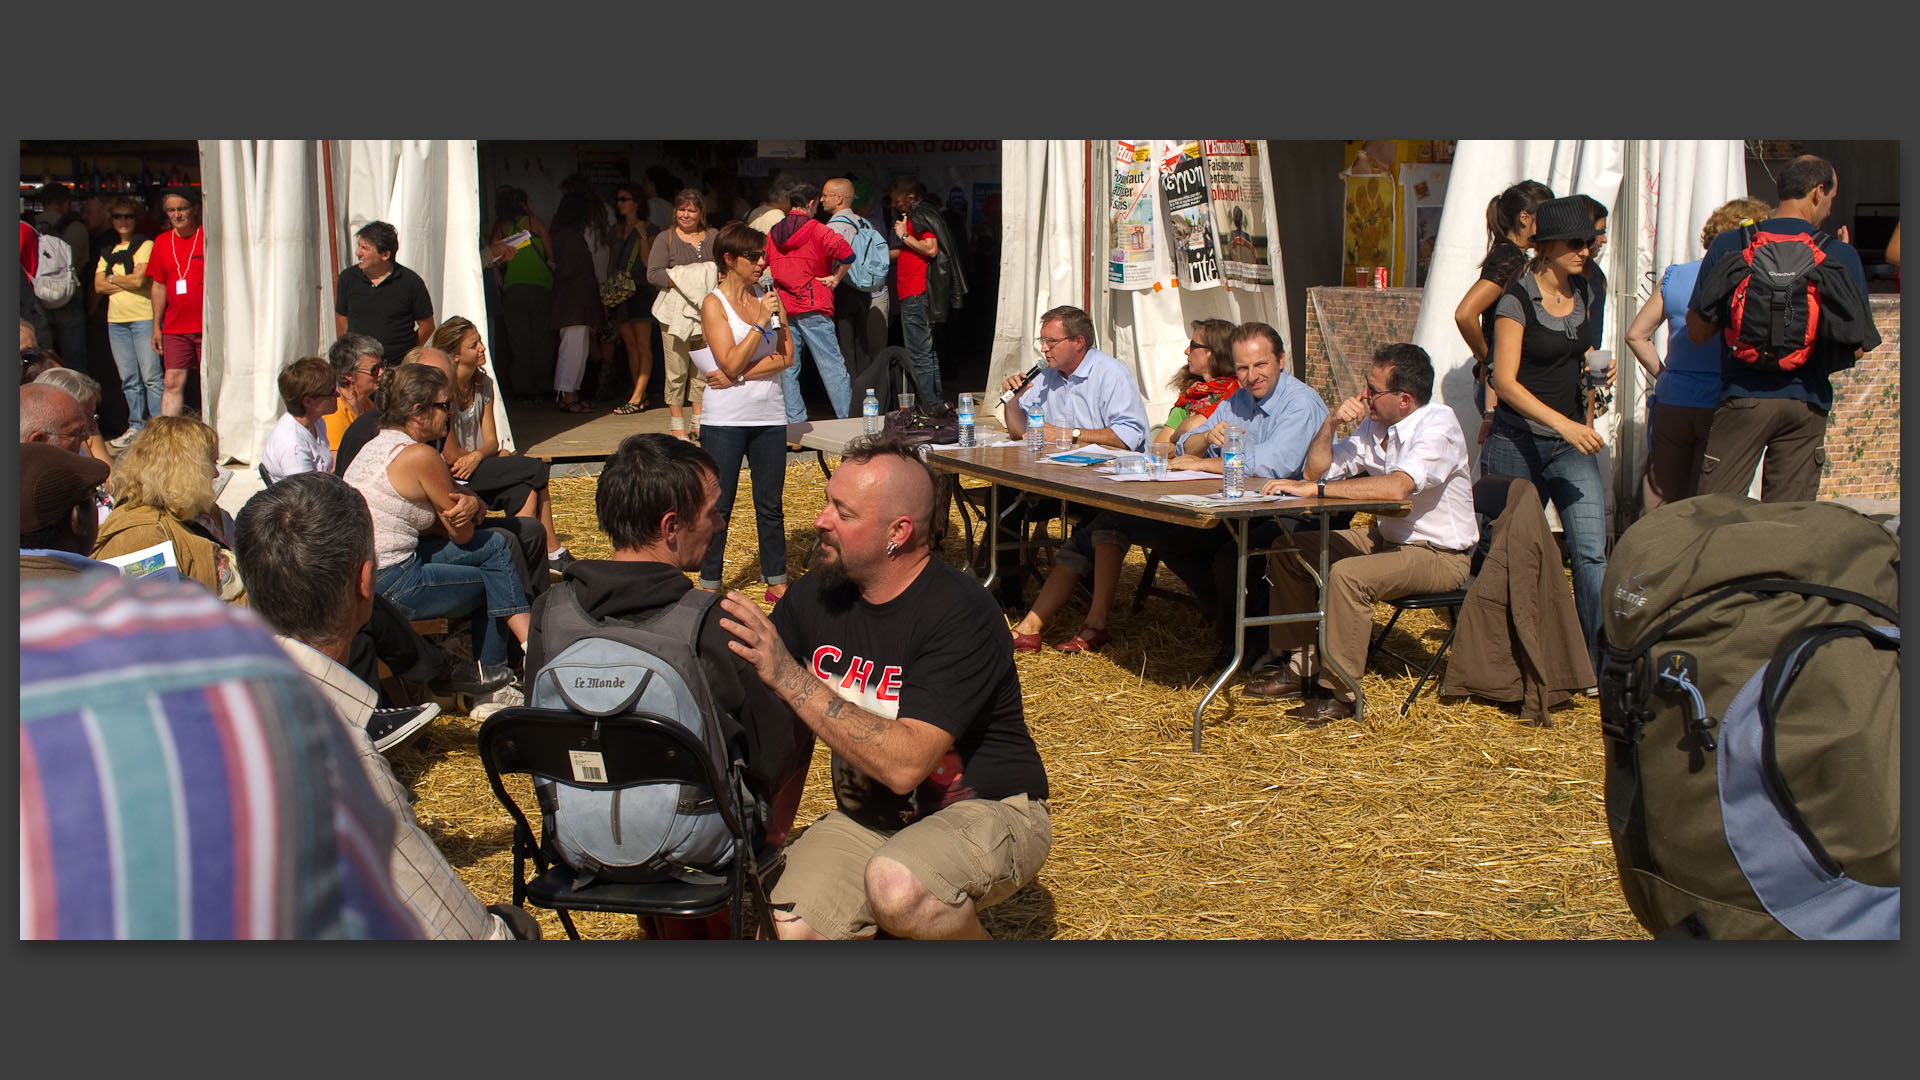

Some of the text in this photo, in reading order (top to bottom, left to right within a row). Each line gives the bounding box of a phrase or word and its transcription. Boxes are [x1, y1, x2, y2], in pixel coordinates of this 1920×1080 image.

[573, 677, 626, 689] Le Monde
[812, 644, 903, 702] CHE
